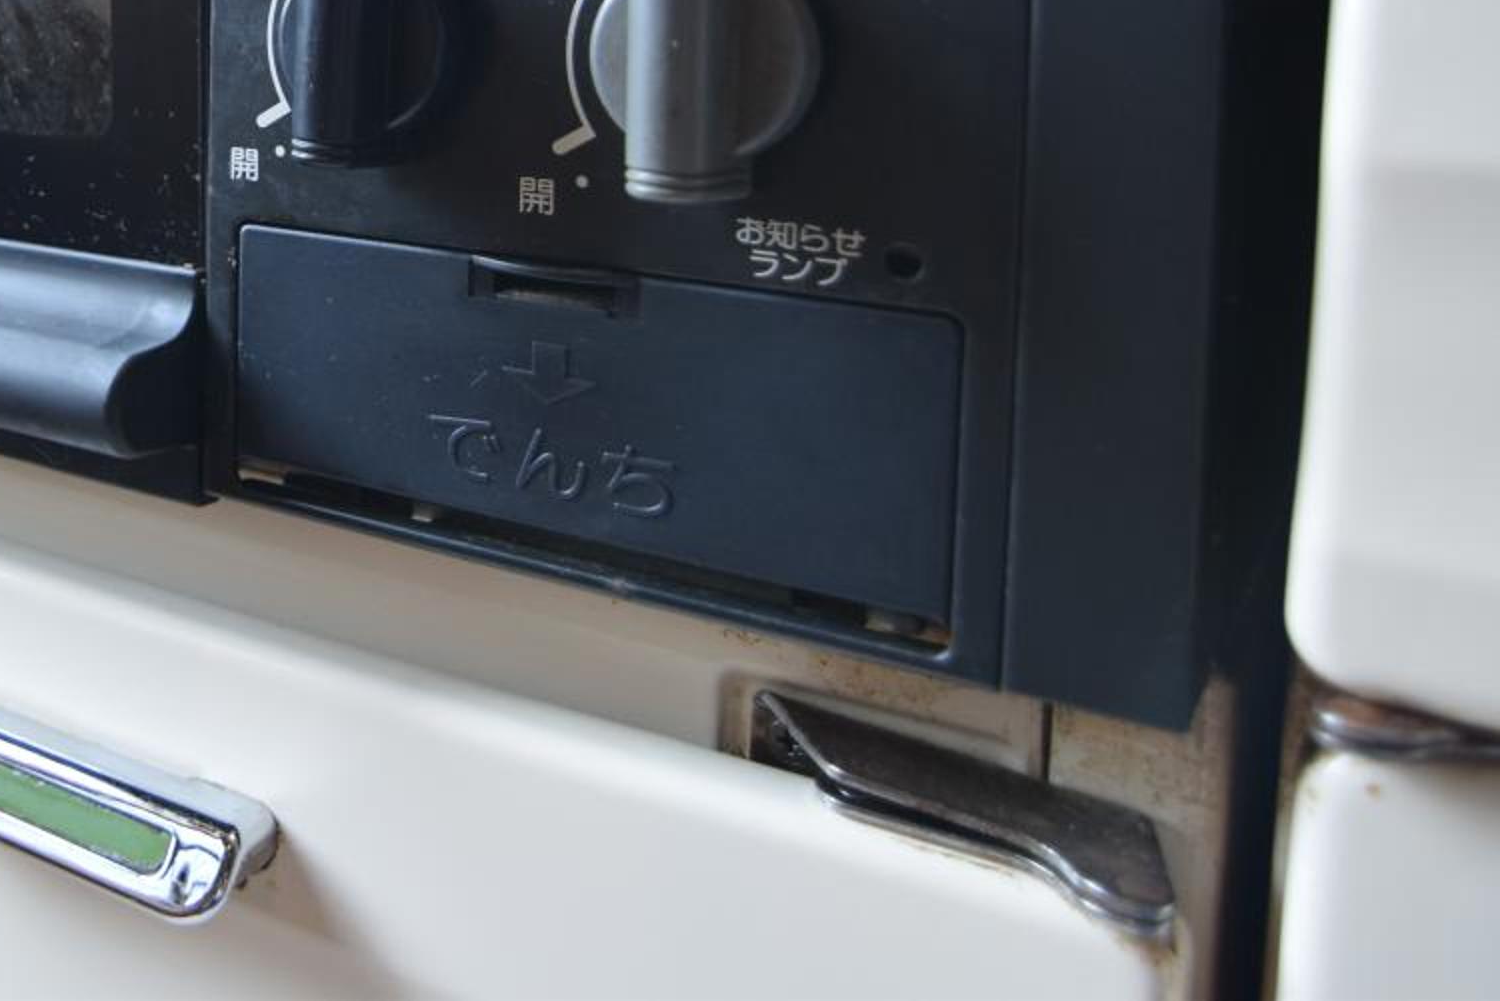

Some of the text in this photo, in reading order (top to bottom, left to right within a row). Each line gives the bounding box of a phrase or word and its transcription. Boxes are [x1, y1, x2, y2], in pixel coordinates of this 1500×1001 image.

[230, 146, 260, 182] 開
[518, 176, 555, 216] 開
[735, 216, 867, 258] お知らせ
[748, 248, 849, 287] ランプ
[427, 412, 676, 518] でんち
